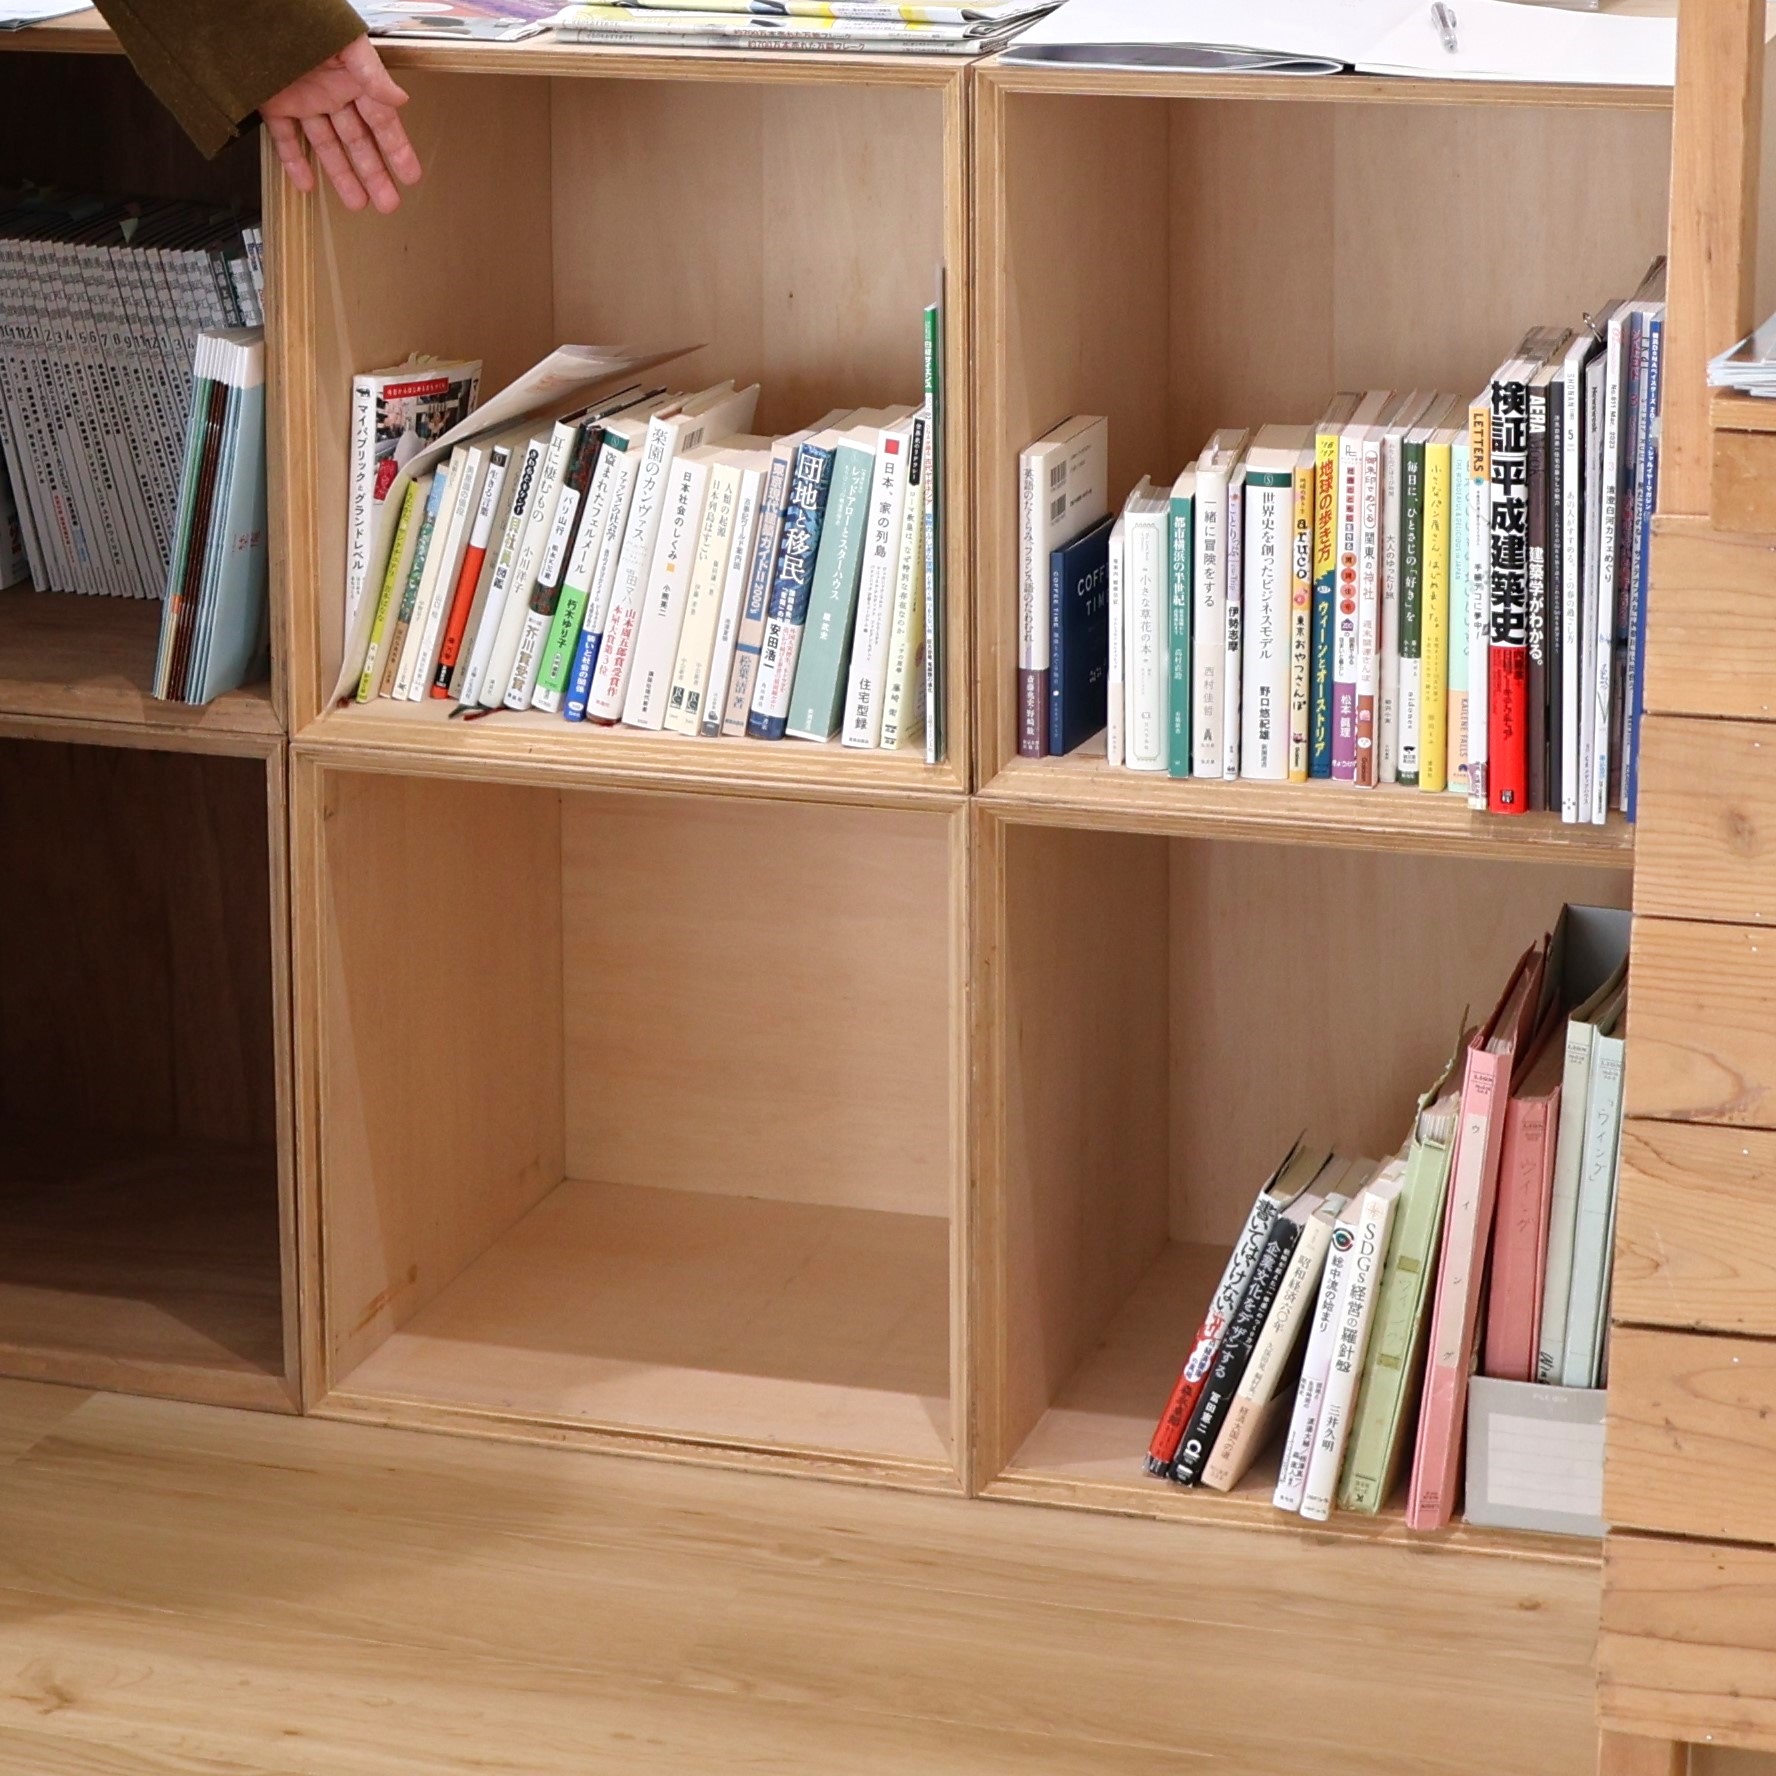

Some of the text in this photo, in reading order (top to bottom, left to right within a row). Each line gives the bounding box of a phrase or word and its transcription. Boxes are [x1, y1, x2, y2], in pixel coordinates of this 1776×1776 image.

[1490, 380, 1528, 453] 検証
[1528, 394, 1546, 434] AERA
[1566, 373, 1575, 408] SHONAN
[1321, 440, 1335, 449] '16
[1321, 449, 1335, 457] '17
[1473, 413, 1484, 473] LETTERS
[1567, 428, 1574, 440] 5
[351, 404, 369, 570] マイパブリックとグランドレベル
[479, 469, 499, 517] 生きる言葉
[532, 435, 565, 523] 耳に棲むもの
[575, 451, 618, 575] 盗まれたフェルメール
[604, 470, 629, 542] ファッションの社会学
[632, 428, 669, 543] 楽園のカンヴァス
[715, 482, 733, 538] 人類の起源
[875, 462, 896, 558] 日本、家の列島
[1317, 458, 1335, 564] 地球の歩き方
[1364, 456, 1378, 523] 御朱印でめぐる
[554, 496, 574, 537] バリ山行
[667, 471, 693, 561] 日本社会のしくみ
[698, 479, 722, 561] 日本列島はすごい
[779, 452, 824, 586] 団地と移民
[829, 465, 860, 601] レッドアローとスターハウス
[1228, 510, 1241, 558] ことりっぷ
[1296, 518, 1309, 580] aruco
[1403, 459, 1419, 623] 毎日に、ひとさじの「好き」を
[1427, 464, 1443, 629] 小さなパン屋さん、はじめました。
[1490, 458, 1527, 645] 平成建築史
[1603, 485, 1616, 583] 清澄白河カフェめぐり
[513, 546, 534, 594] 小川洋子
[895, 492, 916, 636] ローマ教皇は、なぜ特別な存在なのか
[1023, 467, 1035, 642] 英語のたくらみ、フランス語のたわむれ
[1173, 516, 1186, 607] 都市横浜の半世紀
[1203, 499, 1217, 608] 一緒に冒険をする
[1259, 491, 1275, 659] 世界史を創ったビジネスモデル
[1362, 532, 1376, 601] 関東の神社
[1385, 535, 1395, 601] 大人のゆったり旅
[1566, 491, 1575, 645] あの人がすすめる、この春の過ごし方
[557, 598, 579, 649] 朽木ゆり子
[657, 583, 672, 618] 小熊英二
[1139, 574, 1153, 654] 小さな草花の本
[1227, 606, 1240, 653] 伊勢志摩
[1528, 545, 1545, 666] 建築学がわかる。
[511, 624, 541, 693] 芥川賞受賞
[598, 603, 623, 676] 本屋大賞第3位
[607, 608, 637, 698] 山本周五郎賞受賞作
[762, 623, 782, 670] 安田浩一
[1292, 615, 1307, 712] 東京おやつさんぽ
[1361, 620, 1373, 682] 週末開運さんぽ
[854, 677, 872, 730] 住宅型録
[1203, 666, 1214, 717] 西村佳哲
[1258, 685, 1272, 741] 野口悠紀雄
[1314, 600, 1330, 757] ウィーンとオーストリア
[1340, 694, 1352, 714] 松本
[1473, 1074, 1494, 1083] LION
[1567, 1044, 1588, 1053] LION
[1216, 1198, 1277, 1312] 書いてはいけない
[1214, 1240, 1282, 1379] 企業文化をデザインする
[1272, 1254, 1313, 1334] 昭和経済六〇年
[1319, 1255, 1345, 1333] 総中流の始まり
[1335, 1221, 1376, 1374] SDGs経営の羅針盤
[1221, 1405, 1249, 1461] 経済大国への道
[1321, 1404, 1341, 1453] 三井久明
